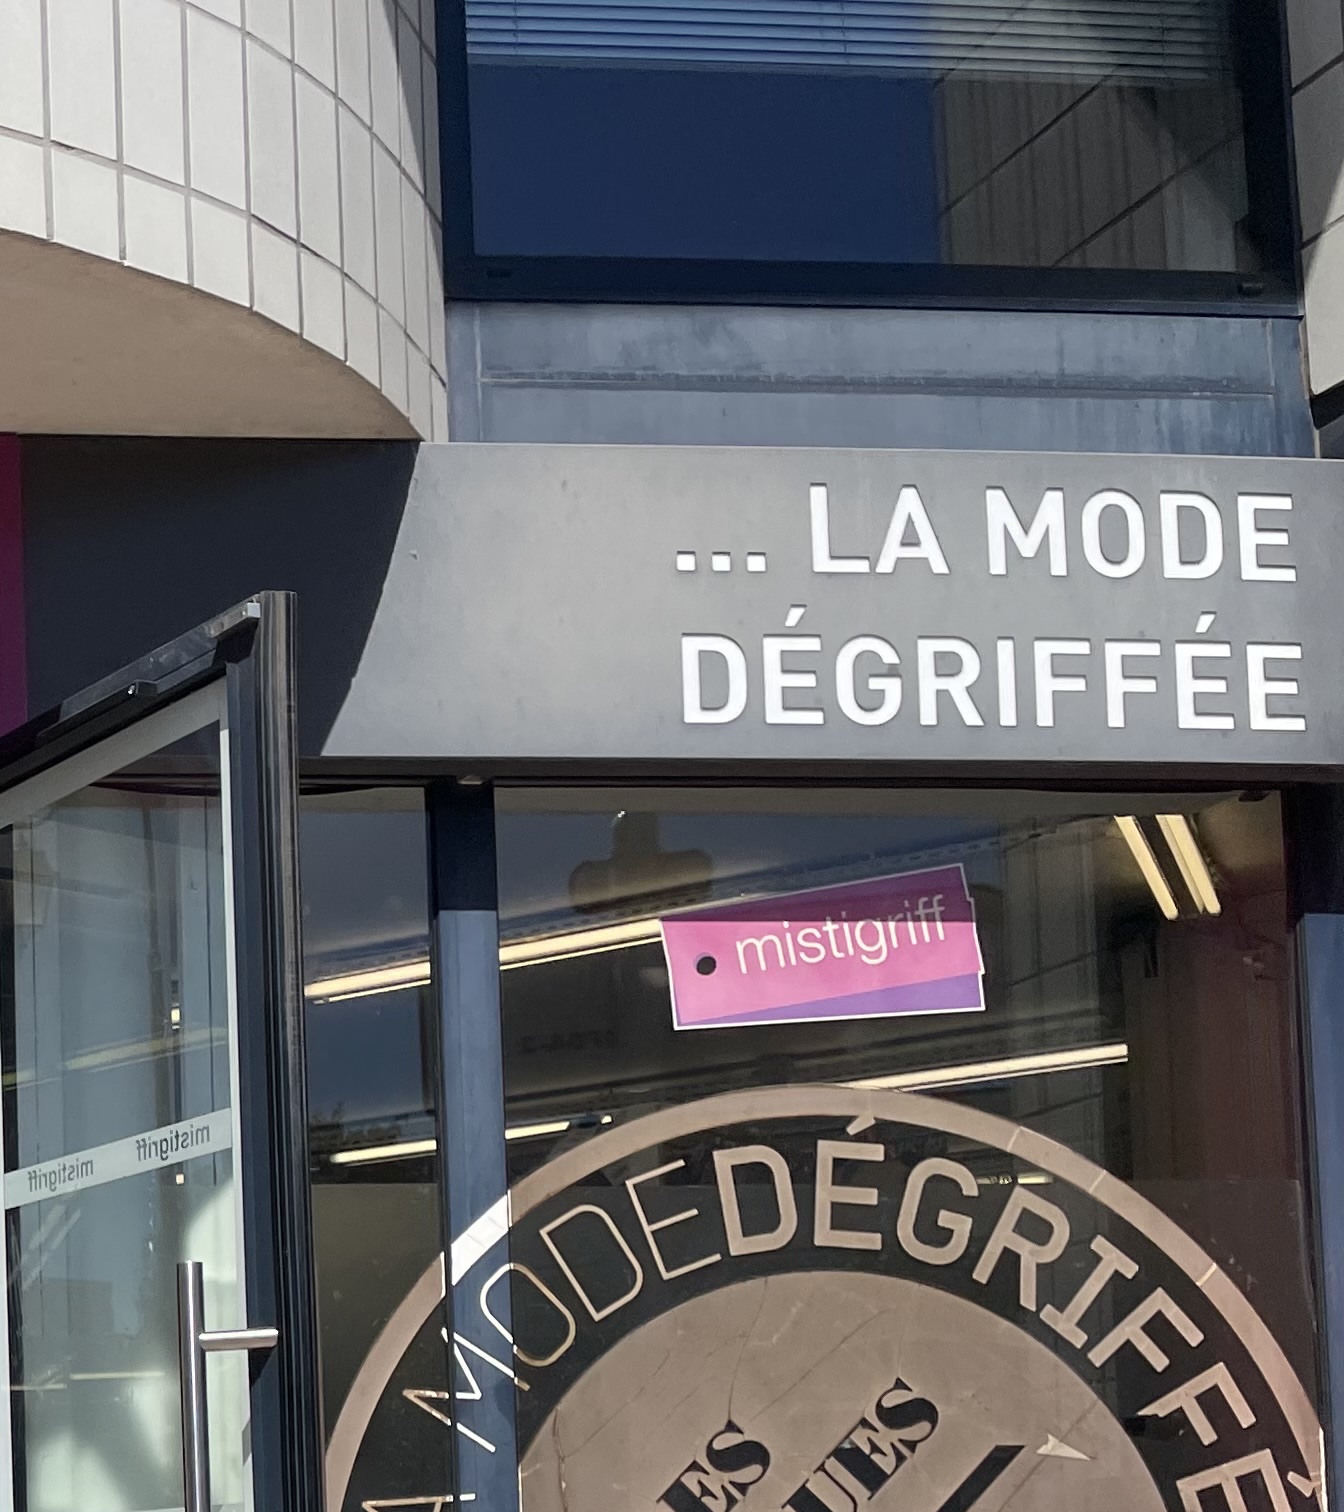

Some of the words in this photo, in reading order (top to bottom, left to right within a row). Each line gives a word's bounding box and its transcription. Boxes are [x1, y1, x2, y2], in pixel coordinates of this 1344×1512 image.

[809, 482, 950, 576] LA
[985, 485, 1298, 583] MODE
[680, 603, 1308, 732] DÉGRIFFÉE
[734, 894, 946, 975] mistigriff
[401, 1156, 723, 1455] MODE
